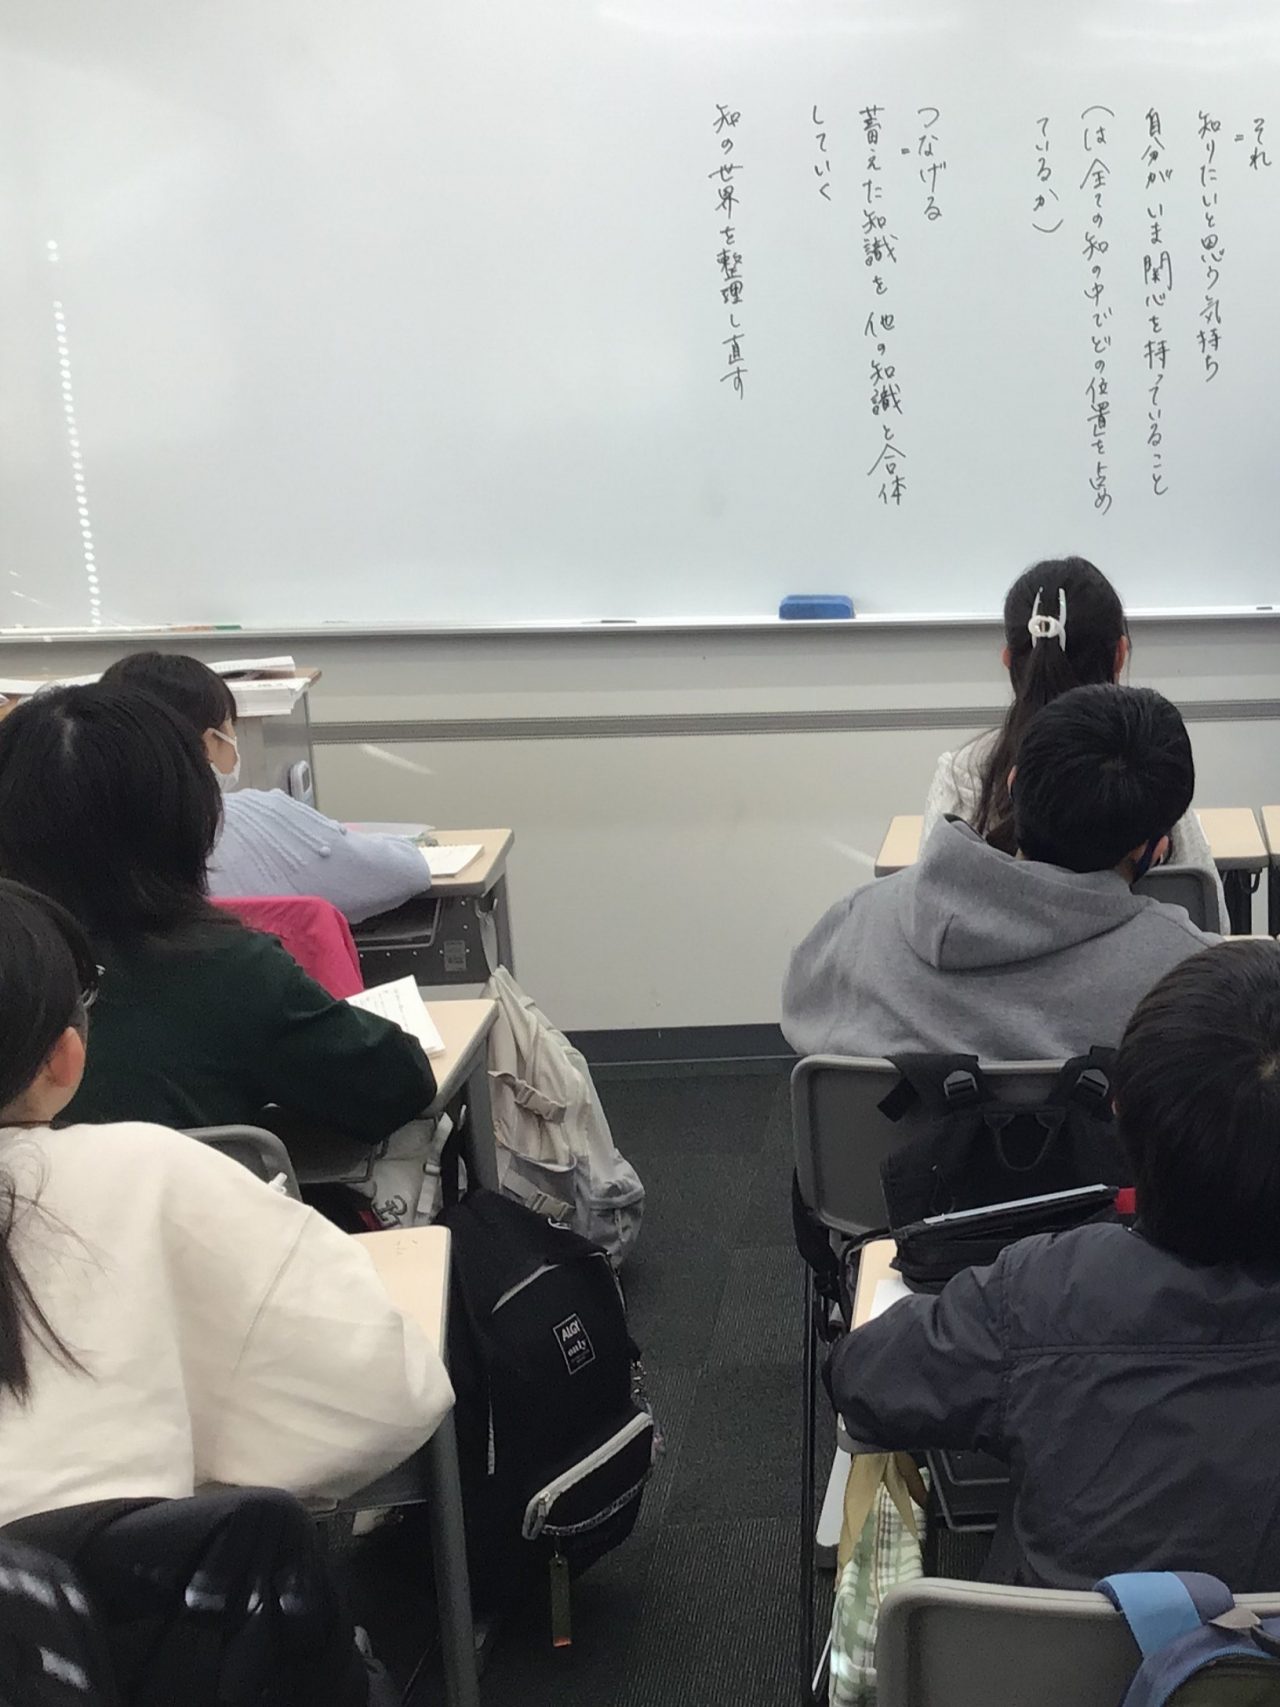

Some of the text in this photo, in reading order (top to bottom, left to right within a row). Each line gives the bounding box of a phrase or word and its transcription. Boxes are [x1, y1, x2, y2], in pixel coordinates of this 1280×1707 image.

[811, 104, 831, 201] していく
[917, 107, 947, 221] つなげる
[1248, 117, 1273, 172] それ
[708, 103, 748, 400] 知の世界を整理し直す
[1196, 110, 1225, 382] 知りたいと思う気持ち
